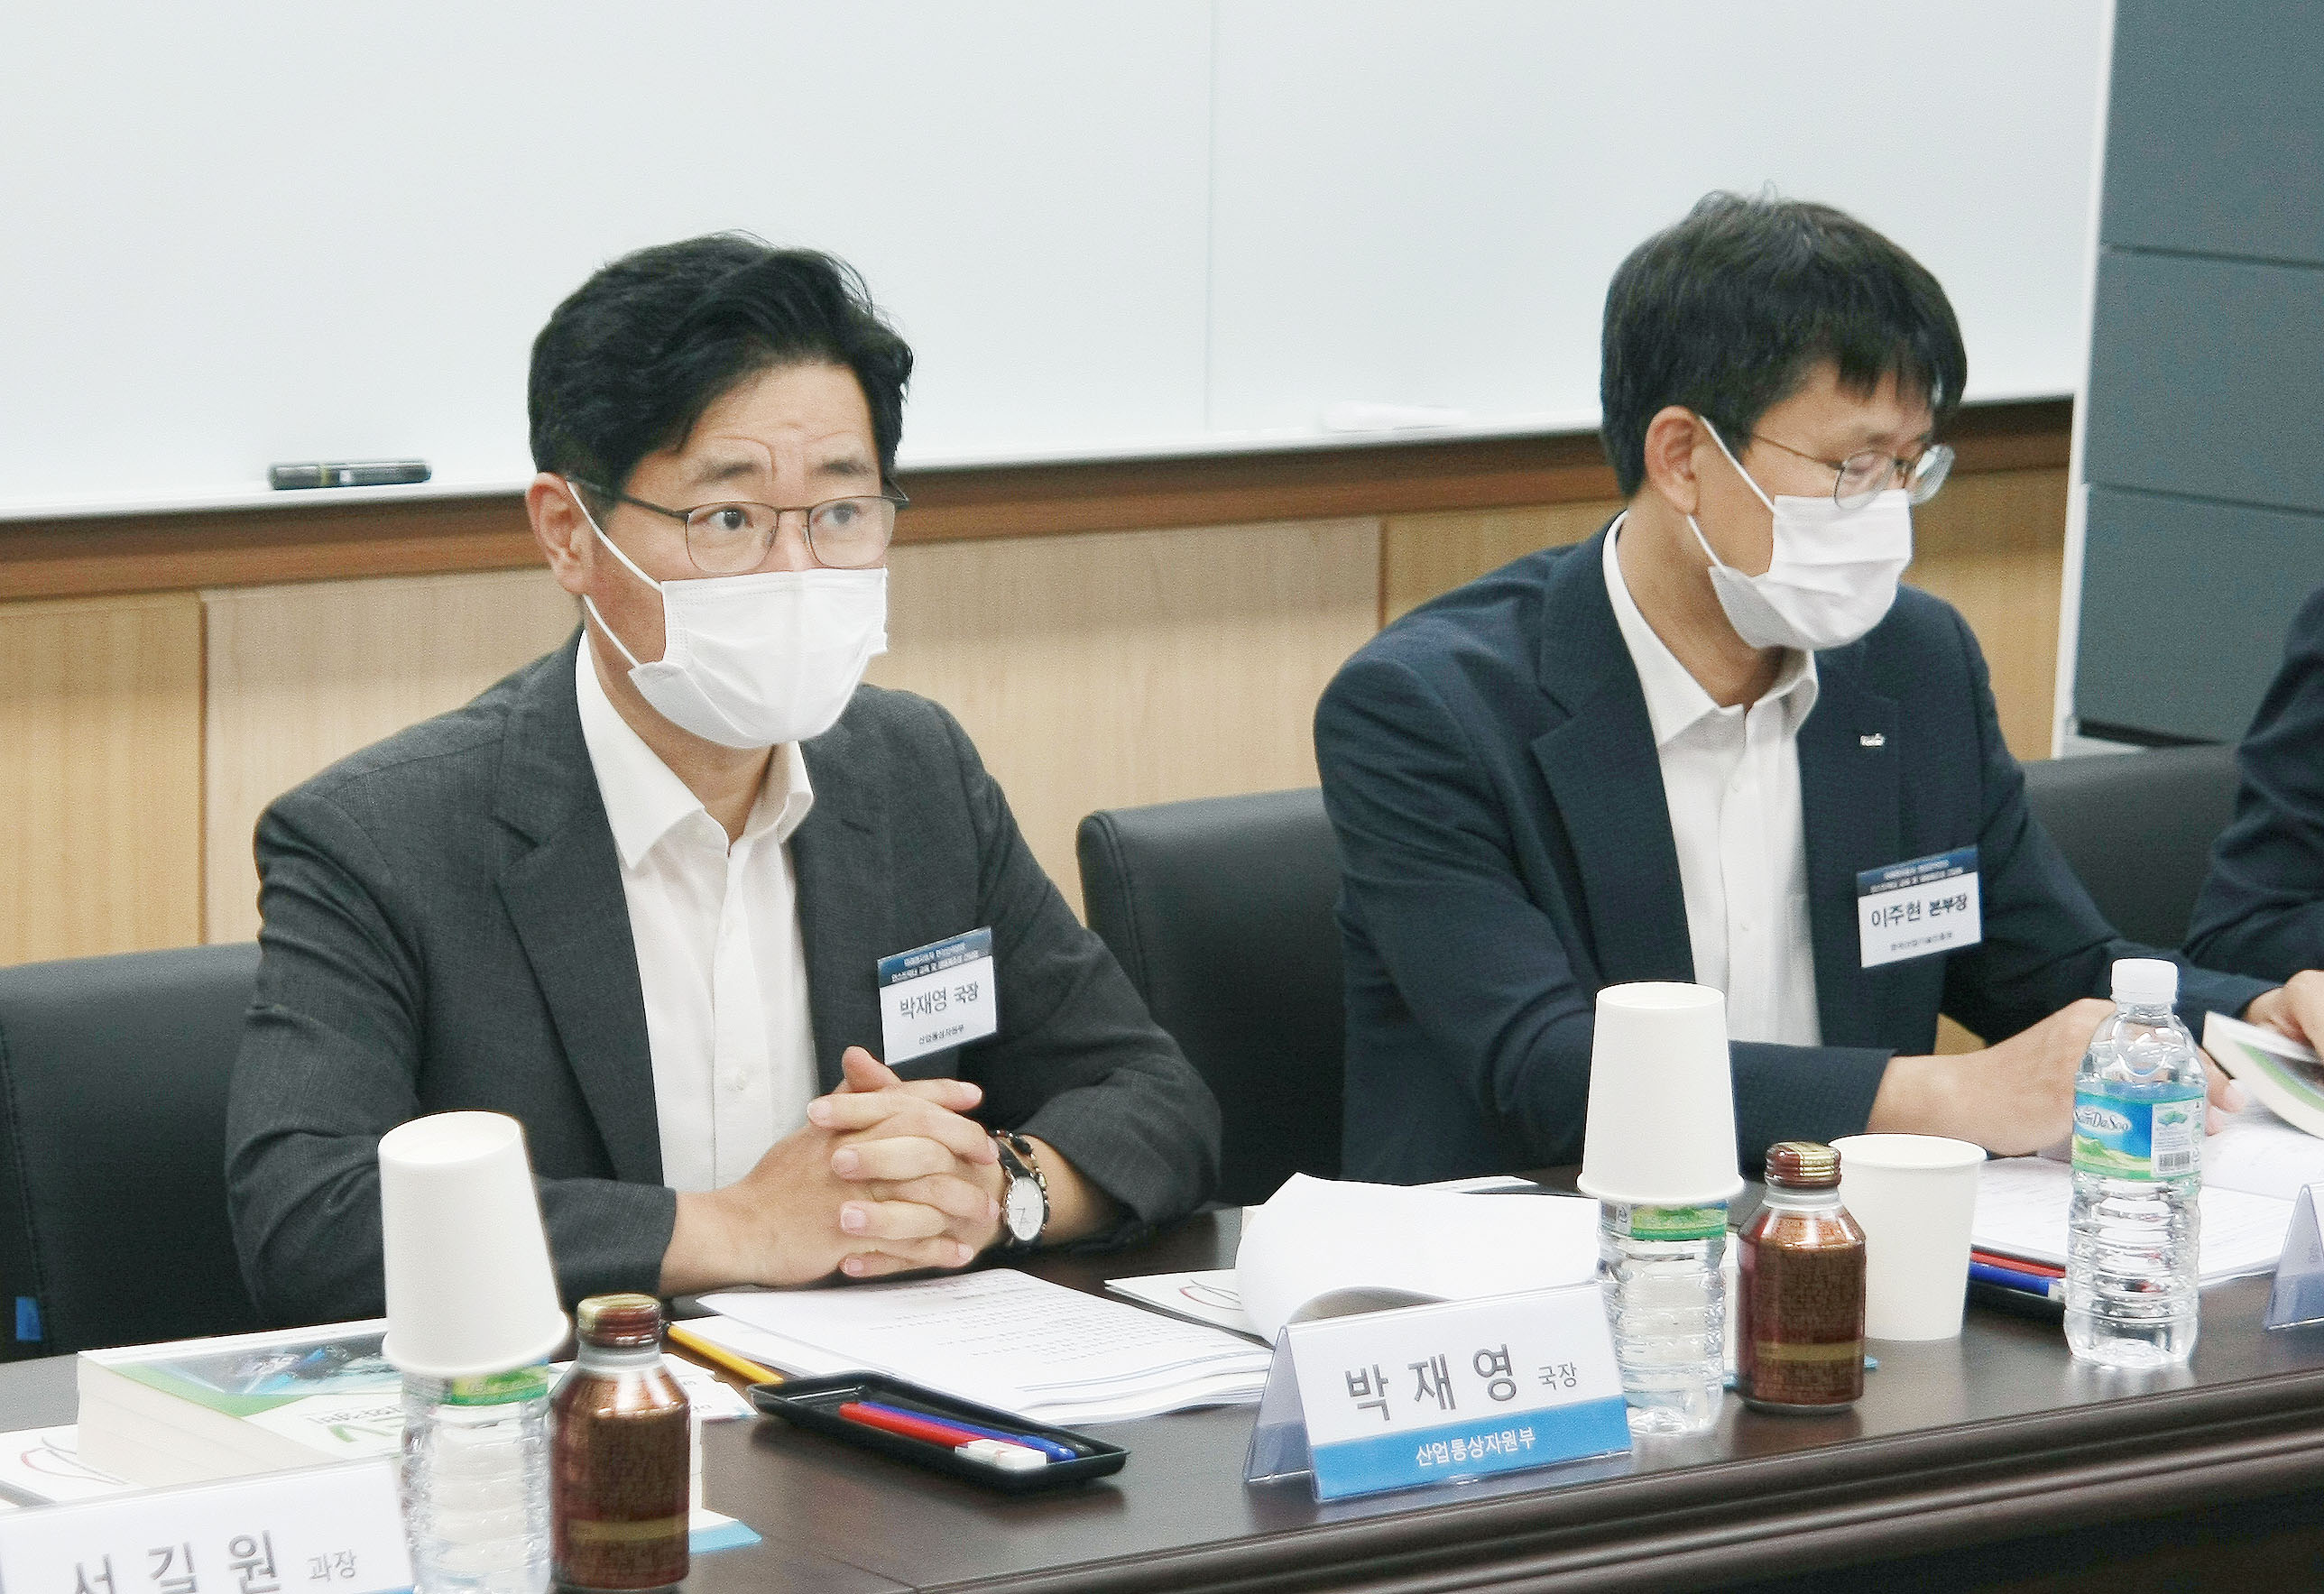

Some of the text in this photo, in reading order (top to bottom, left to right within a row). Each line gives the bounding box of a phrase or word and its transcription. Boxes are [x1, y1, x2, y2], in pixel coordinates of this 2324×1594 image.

[899, 981, 979, 1019] 박재영 국장
[1344, 1343, 1579, 1422] 박재영 국장
[1415, 1426, 1536, 1467] 산업통상자원부
[307, 1548, 357, 1582] 과장
